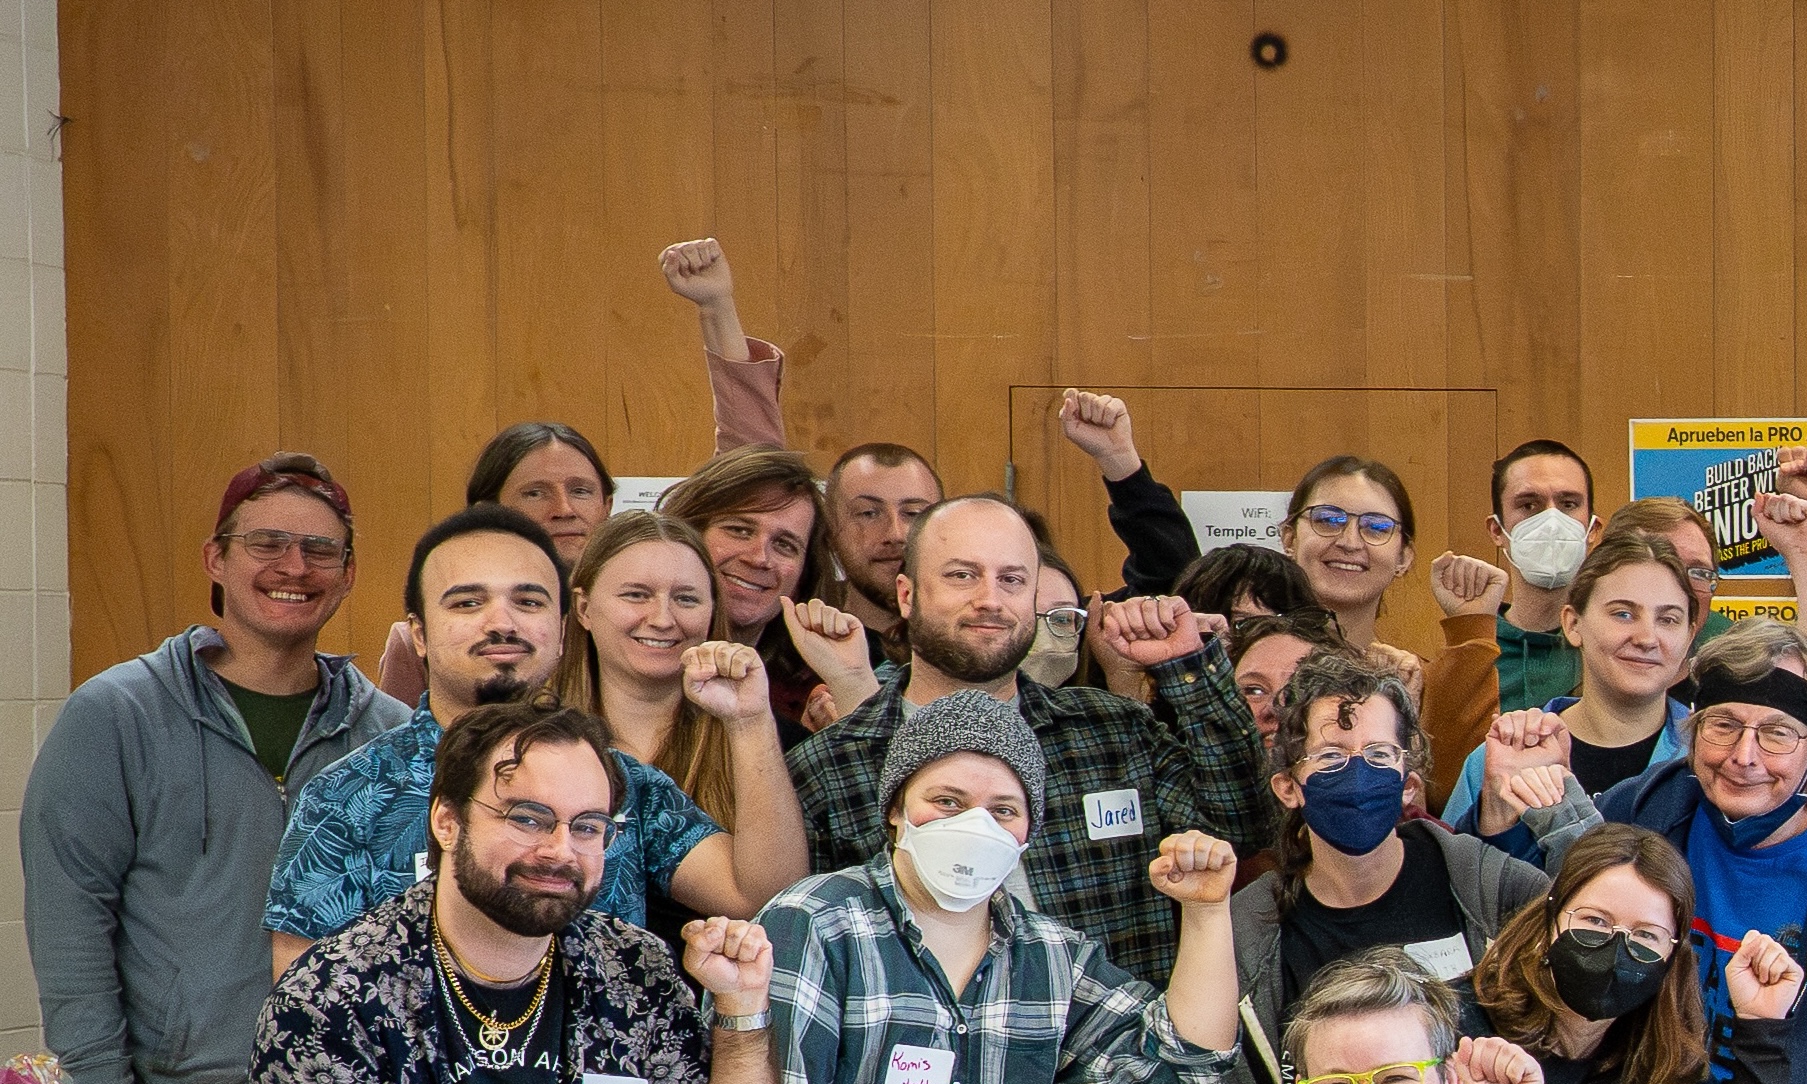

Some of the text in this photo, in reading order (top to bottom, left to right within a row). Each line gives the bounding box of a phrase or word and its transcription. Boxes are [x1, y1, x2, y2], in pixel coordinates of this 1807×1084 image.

[1666, 427, 1745, 446] Aprueben
[1749, 426, 1764, 443] la
[1767, 426, 1803, 443] PRO
[1705, 457, 1744, 487] BUILD
[1693, 476, 1749, 514] BETTER
[1241, 507, 1272, 519] WiFi:
[1734, 542, 1750, 557] THE
[1090, 799, 1137, 829] Jared
[952, 863, 974, 877] 3M
